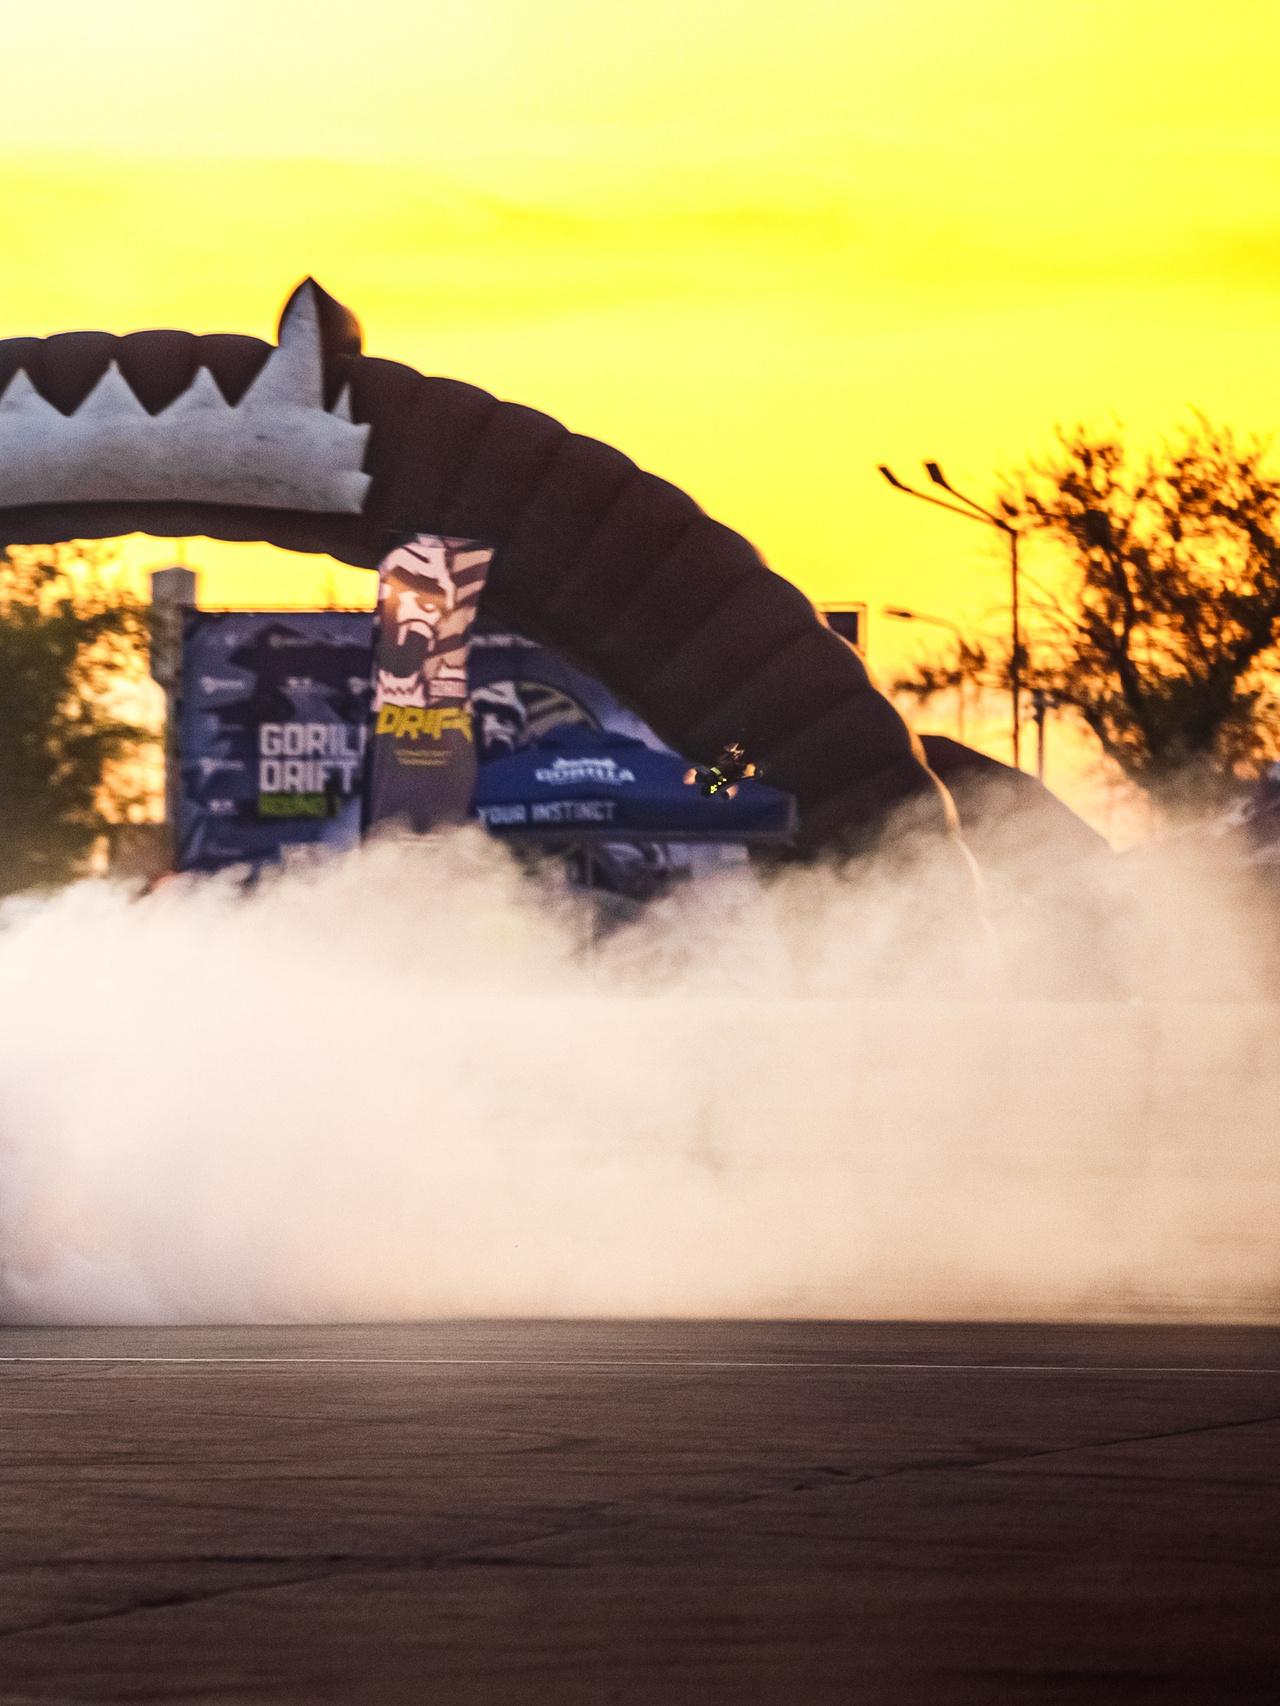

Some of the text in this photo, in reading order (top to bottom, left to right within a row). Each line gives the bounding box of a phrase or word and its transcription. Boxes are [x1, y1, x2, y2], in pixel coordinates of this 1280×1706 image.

[260, 722, 367, 757] GORIL
[260, 760, 358, 793] DRIFT
[532, 800, 616, 822] INSTINCT
